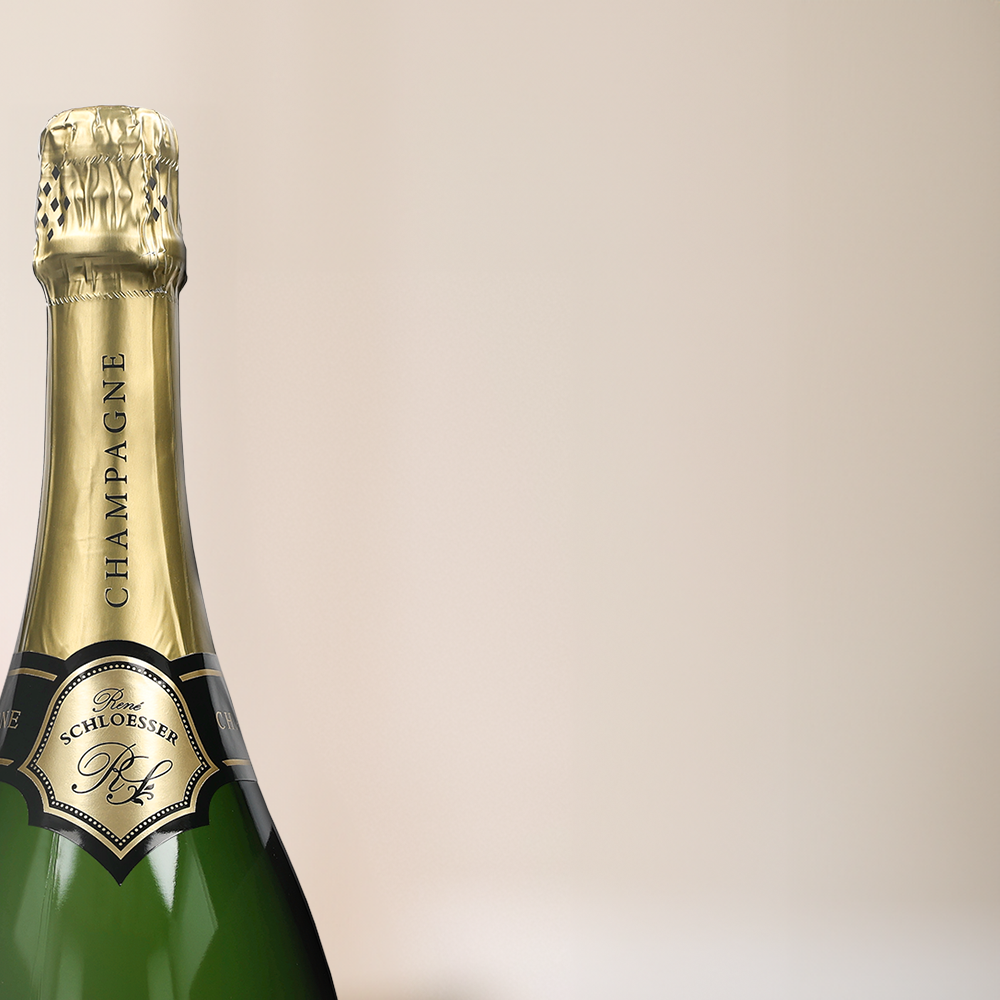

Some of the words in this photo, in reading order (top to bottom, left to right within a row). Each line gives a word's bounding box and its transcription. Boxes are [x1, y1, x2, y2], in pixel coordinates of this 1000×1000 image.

[102, 353, 129, 608] CHAMPAGNE
[92, 688, 144, 712] René
[60, 712, 179, 746] SCHLOESSER
